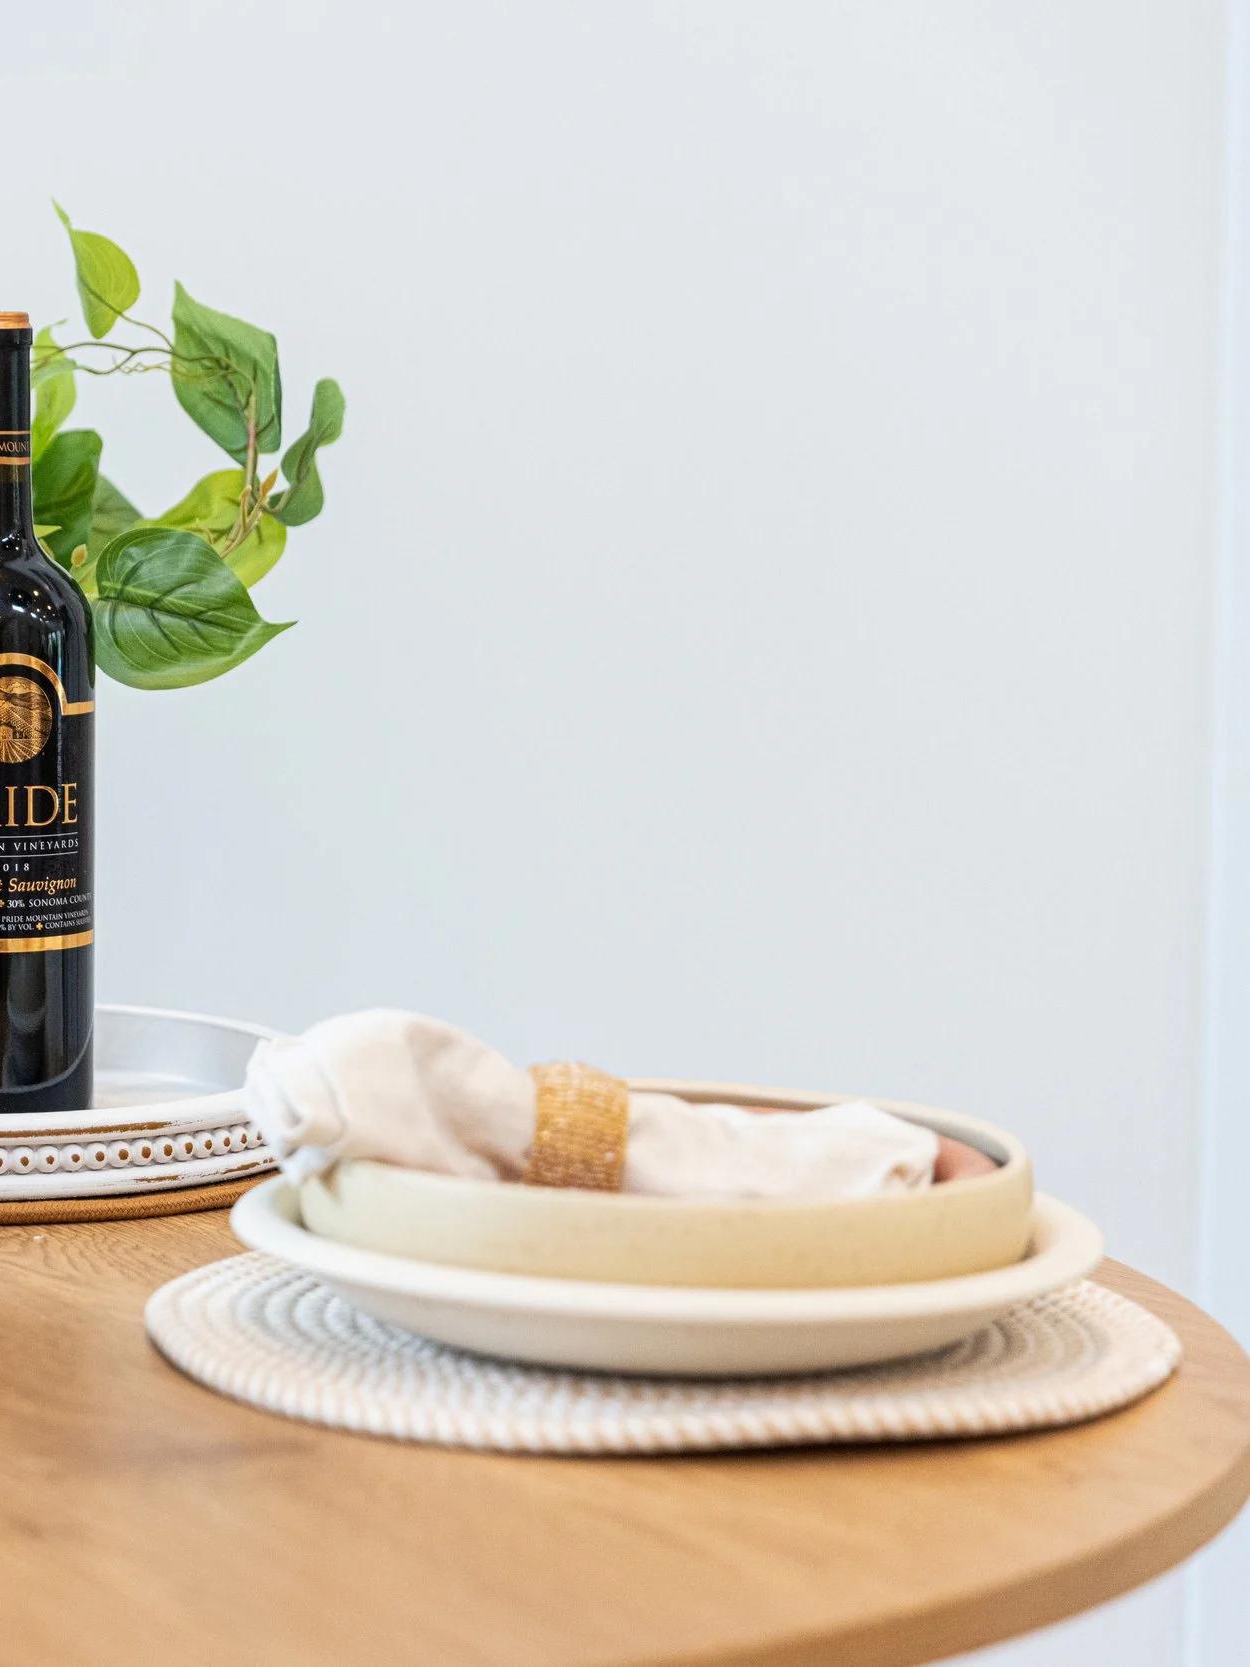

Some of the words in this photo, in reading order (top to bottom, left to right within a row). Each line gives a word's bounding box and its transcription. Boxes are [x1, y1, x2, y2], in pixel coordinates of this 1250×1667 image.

[13, 838, 79, 850] VINEYARDS
[8, 877, 77, 895] Sauvignon
[6, 900, 25, 908] 30%
[28, 897, 68, 908] SONOMA
[1, 915, 24, 923] PRIDE
[25, 913, 64, 922] MOUNTAIN
[7, 923, 17, 931] BY
[17, 923, 35, 931] VOL.
[44, 920, 76, 930] CONTAINS
